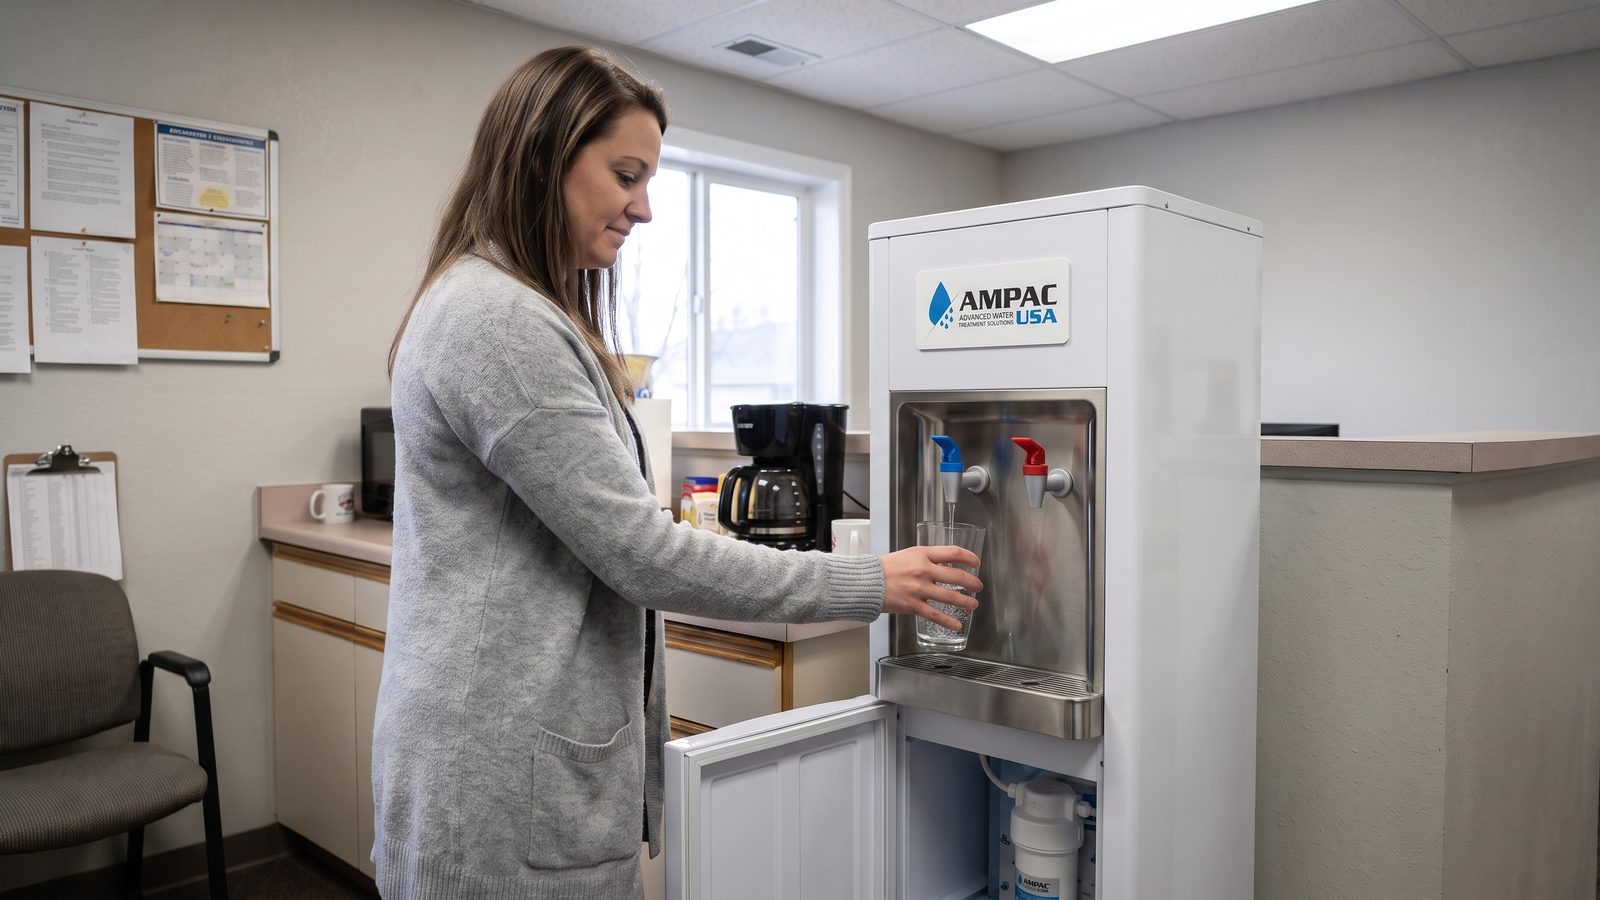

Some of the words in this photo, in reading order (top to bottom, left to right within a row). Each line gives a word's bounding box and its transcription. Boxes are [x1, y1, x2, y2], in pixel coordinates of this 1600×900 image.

[960, 284, 1057, 311] AMPAC
[960, 313, 991, 321] ADVANCED
[1016, 309, 1057, 325] USA
[1024, 879, 1051, 889] AMPAC
